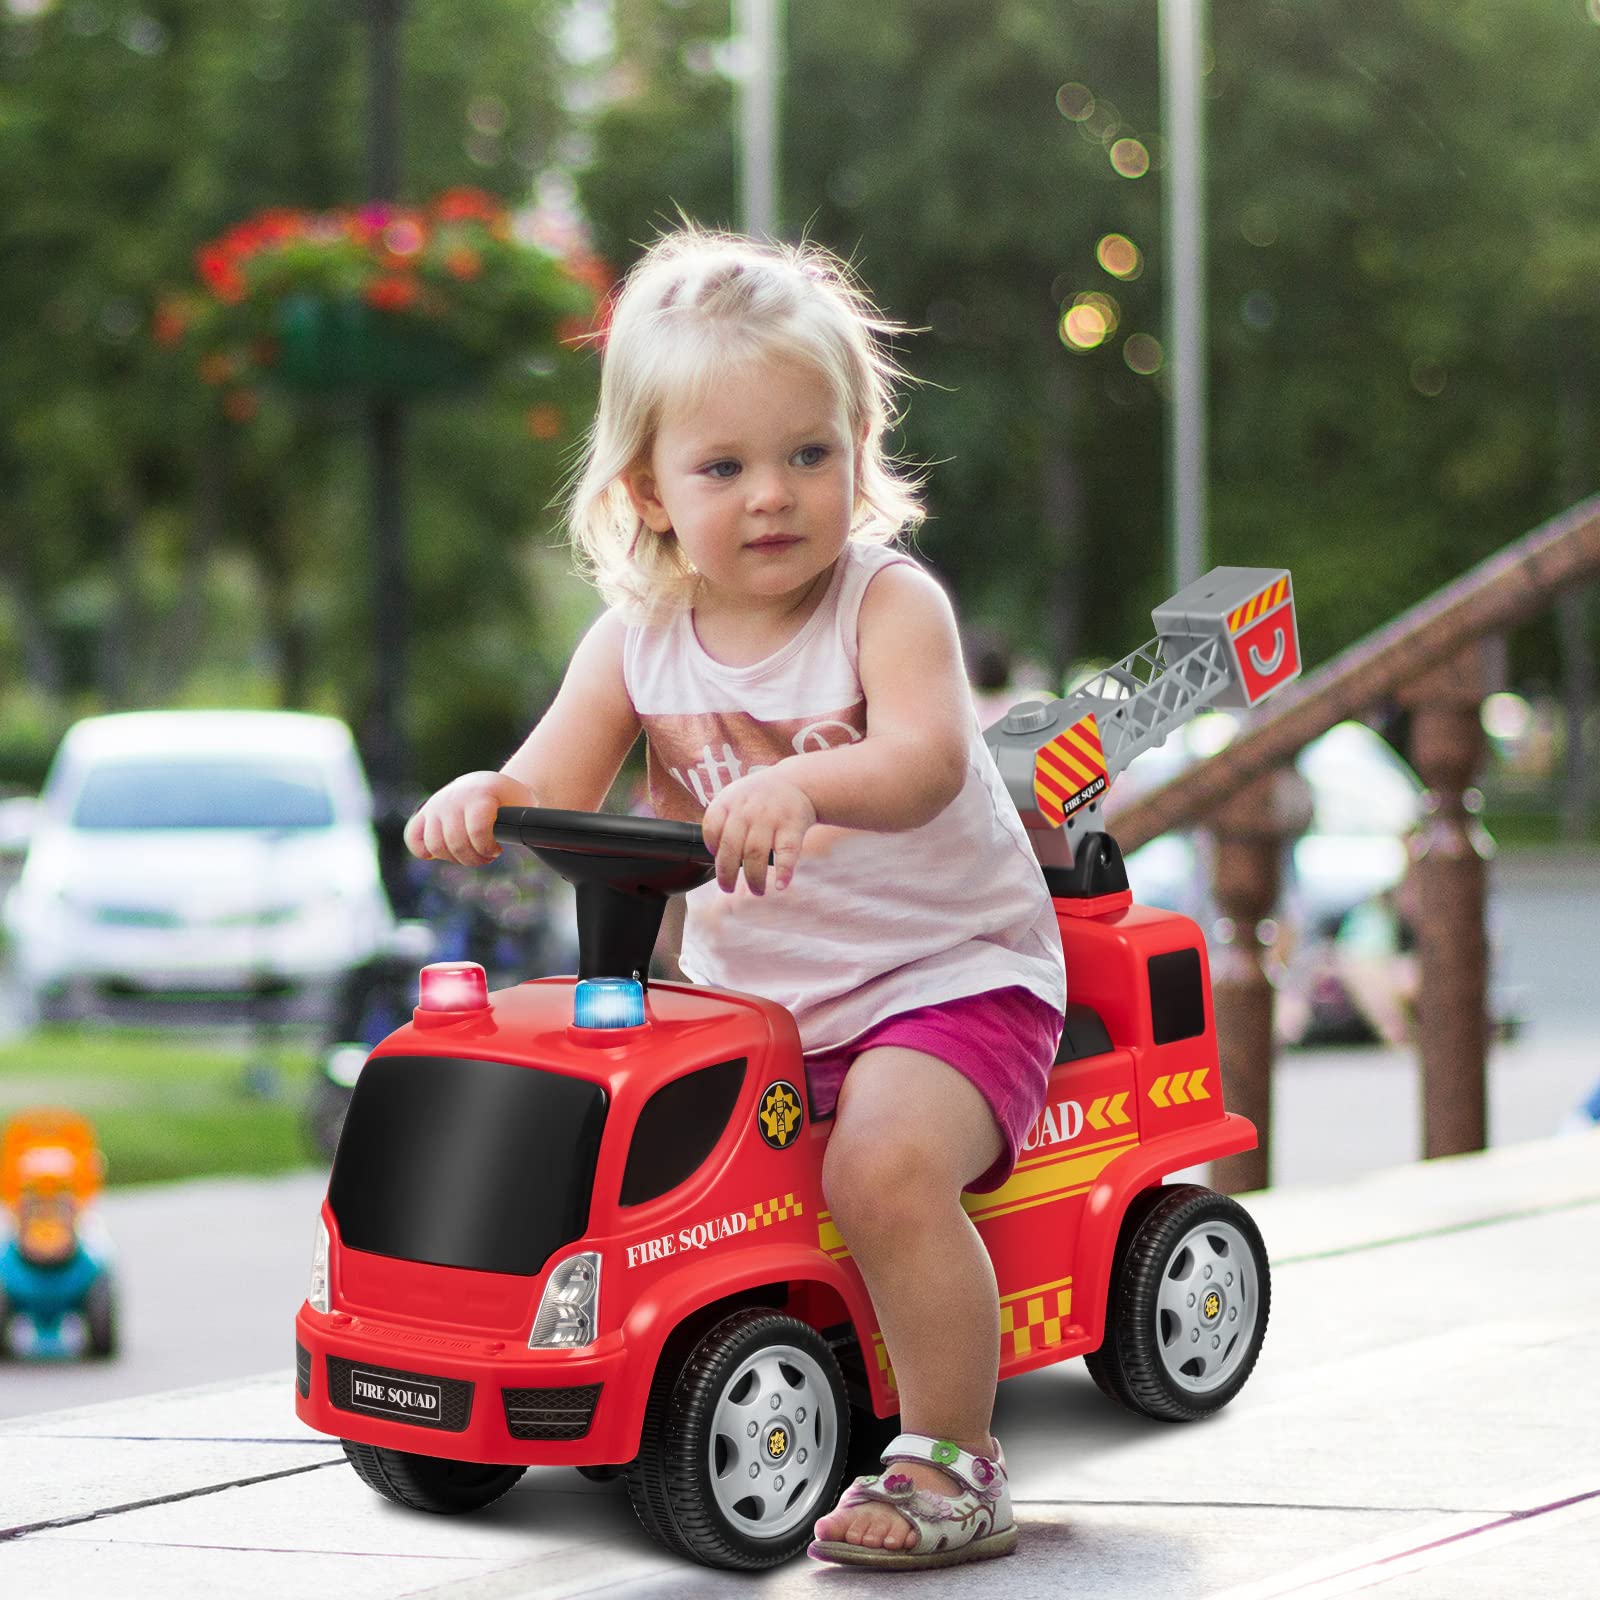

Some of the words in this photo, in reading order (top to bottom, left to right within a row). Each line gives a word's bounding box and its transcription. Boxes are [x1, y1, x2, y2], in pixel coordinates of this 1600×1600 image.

[1064, 796, 1081, 813] FIRE
[1082, 778, 1105, 800] SQUAD
[625, 1234, 676, 1268] FIRE
[678, 1212, 747, 1251] SQUAD
[355, 1380, 385, 1400] FIRE
[388, 1388, 437, 1409] SQUAD
